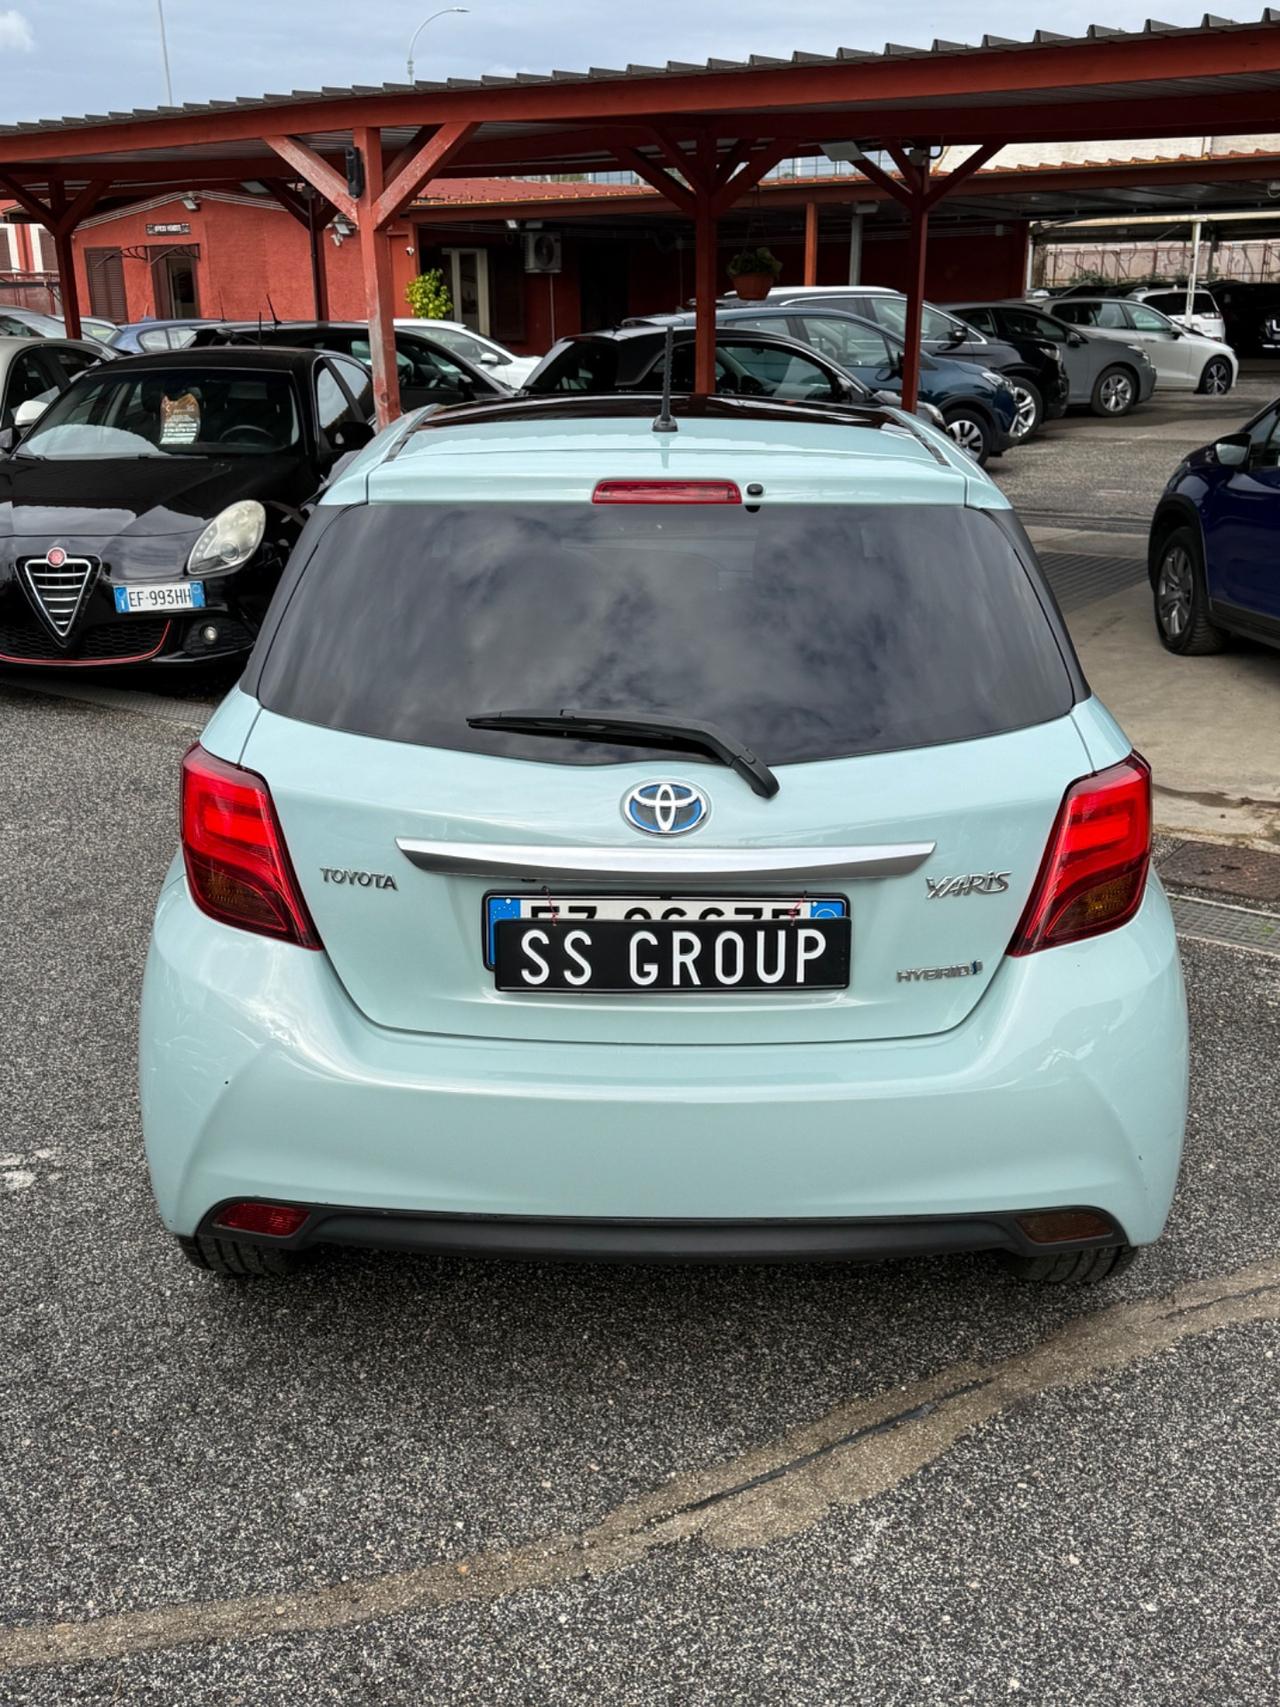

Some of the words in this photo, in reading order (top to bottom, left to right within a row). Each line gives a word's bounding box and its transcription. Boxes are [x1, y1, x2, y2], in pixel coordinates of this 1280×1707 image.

[320, 868, 398, 891] TOYOTA
[520, 929, 592, 985] SS
[628, 928, 826, 985] GROUP
[897, 965, 970, 982] HYBRID
